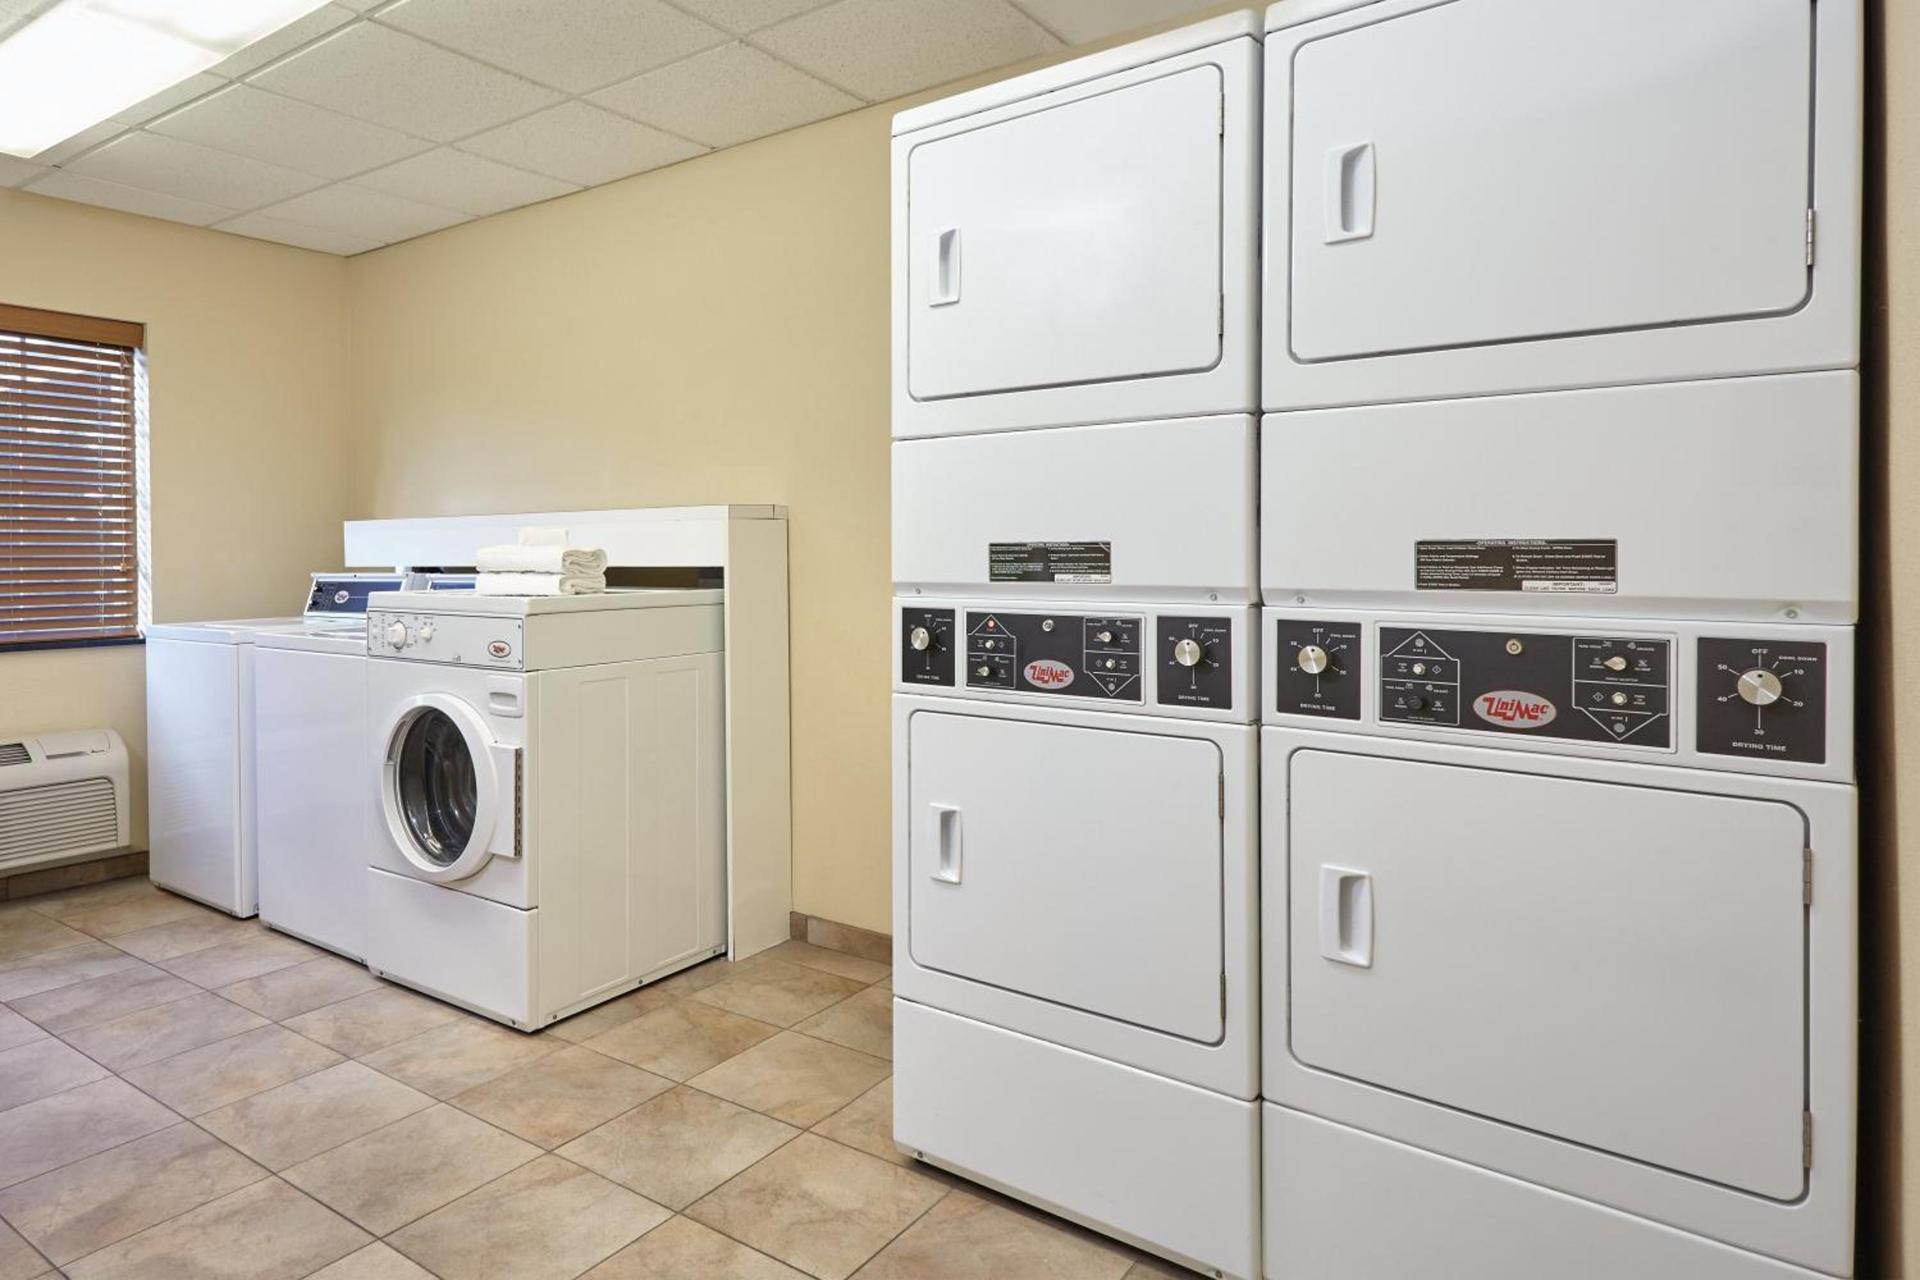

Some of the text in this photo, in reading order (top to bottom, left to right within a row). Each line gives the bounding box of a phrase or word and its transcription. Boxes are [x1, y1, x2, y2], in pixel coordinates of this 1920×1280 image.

[1030, 665, 1070, 683] UniMac
[1483, 697, 1549, 721] UniMac
[1732, 742, 1763, 750] DRYING
